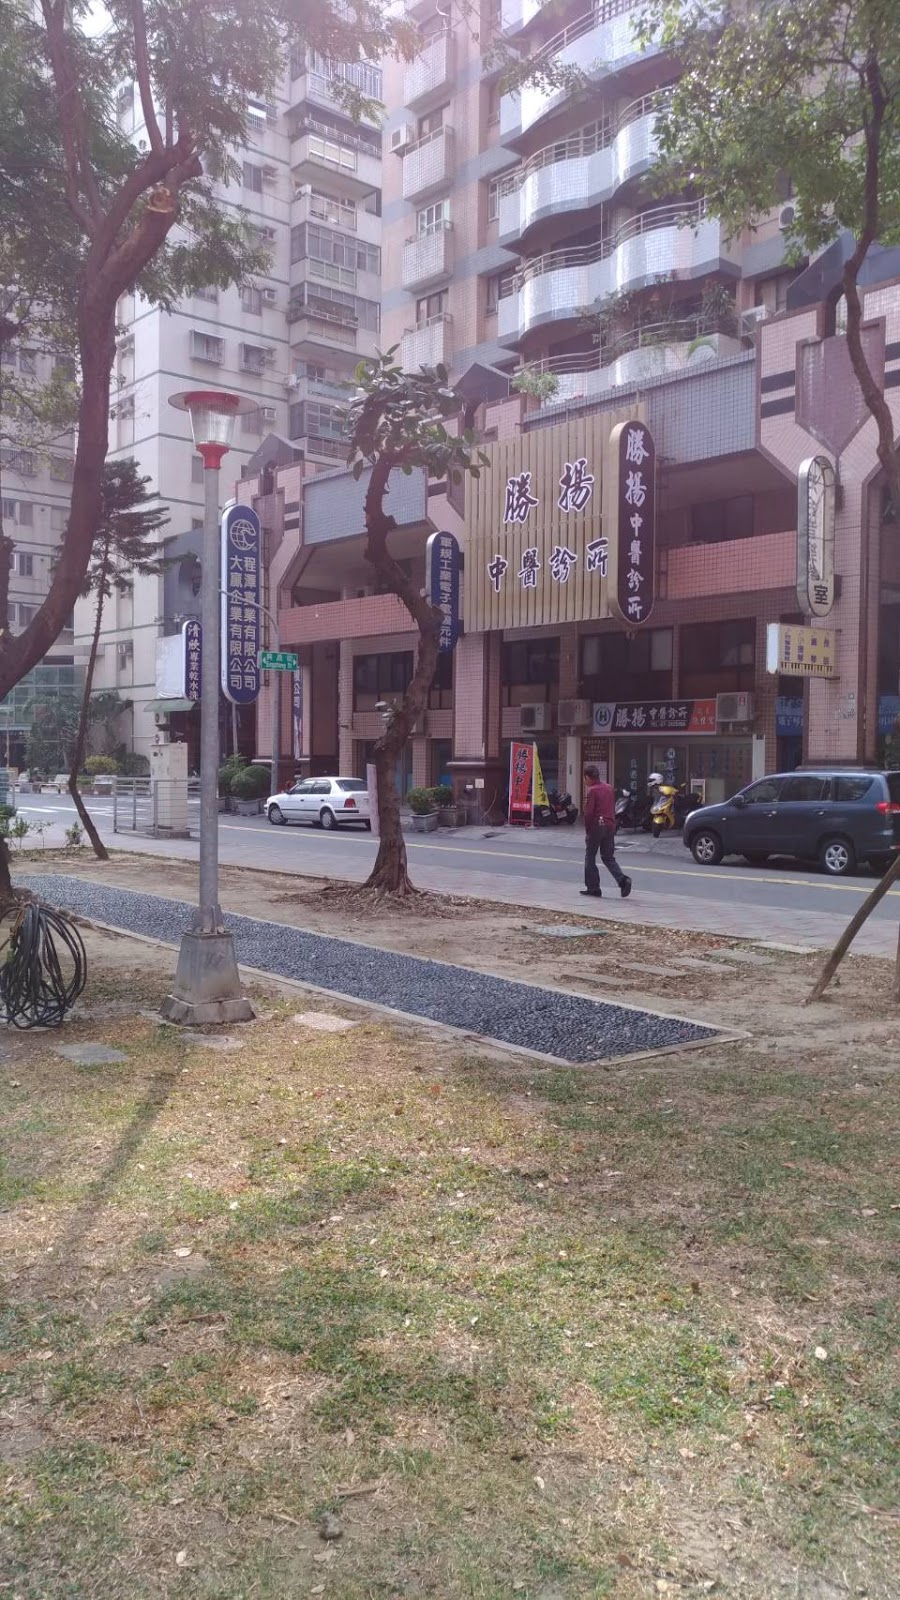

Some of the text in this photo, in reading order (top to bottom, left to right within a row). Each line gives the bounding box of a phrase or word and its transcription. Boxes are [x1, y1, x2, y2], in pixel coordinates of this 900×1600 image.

[503, 458, 595, 524] 勝揚
[625, 428, 650, 620] 勝揚中醫診所
[487, 537, 609, 593] 中醫診所
